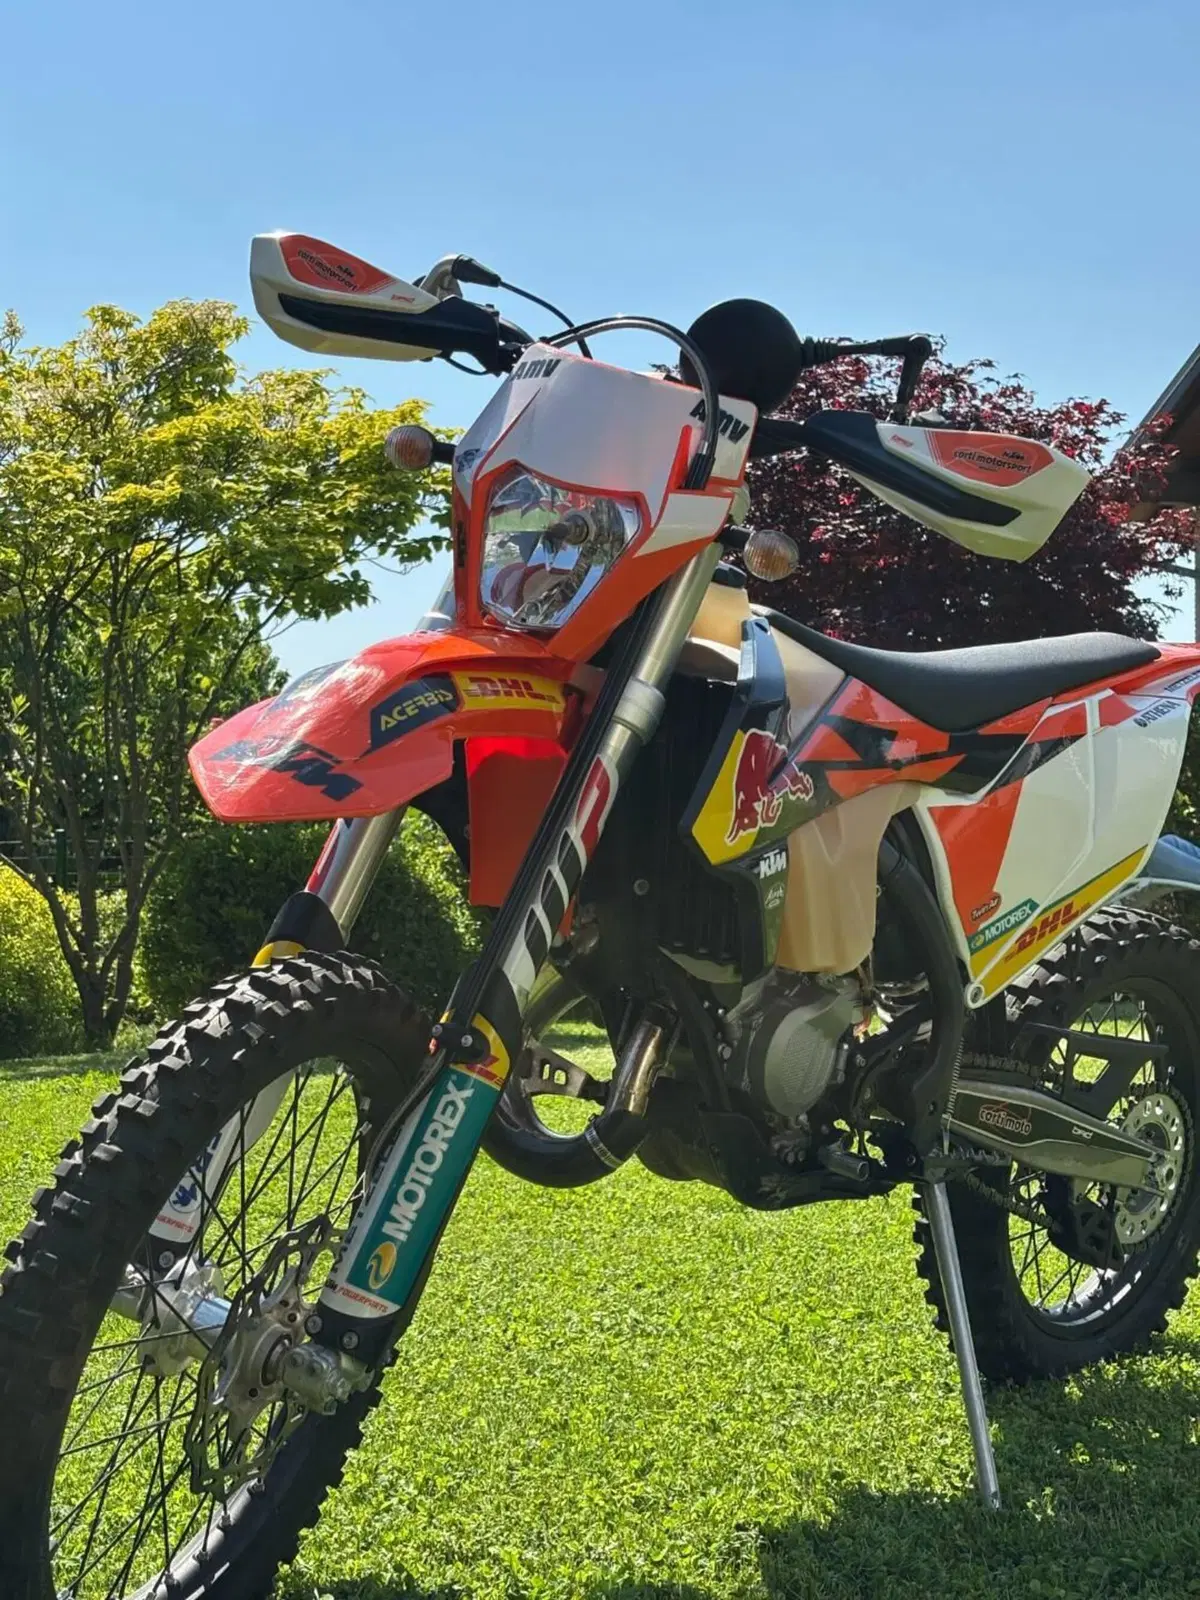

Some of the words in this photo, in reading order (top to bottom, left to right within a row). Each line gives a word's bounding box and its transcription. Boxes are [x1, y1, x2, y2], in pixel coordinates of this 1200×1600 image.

[954, 450, 976, 462] corti
[976, 453, 1032, 473] motorsport
[463, 676, 556, 702] DHL
[380, 688, 455, 732] ACERBIS
[1140, 700, 1181, 724] ATHENA
[759, 848, 787, 879] KTM
[984, 903, 1033, 942] MOTOREX
[1014, 901, 1080, 953] DHL
[979, 1108, 1006, 1128] corti
[1005, 1115, 1032, 1136] moto
[381, 1079, 475, 1243] MOTOREX
